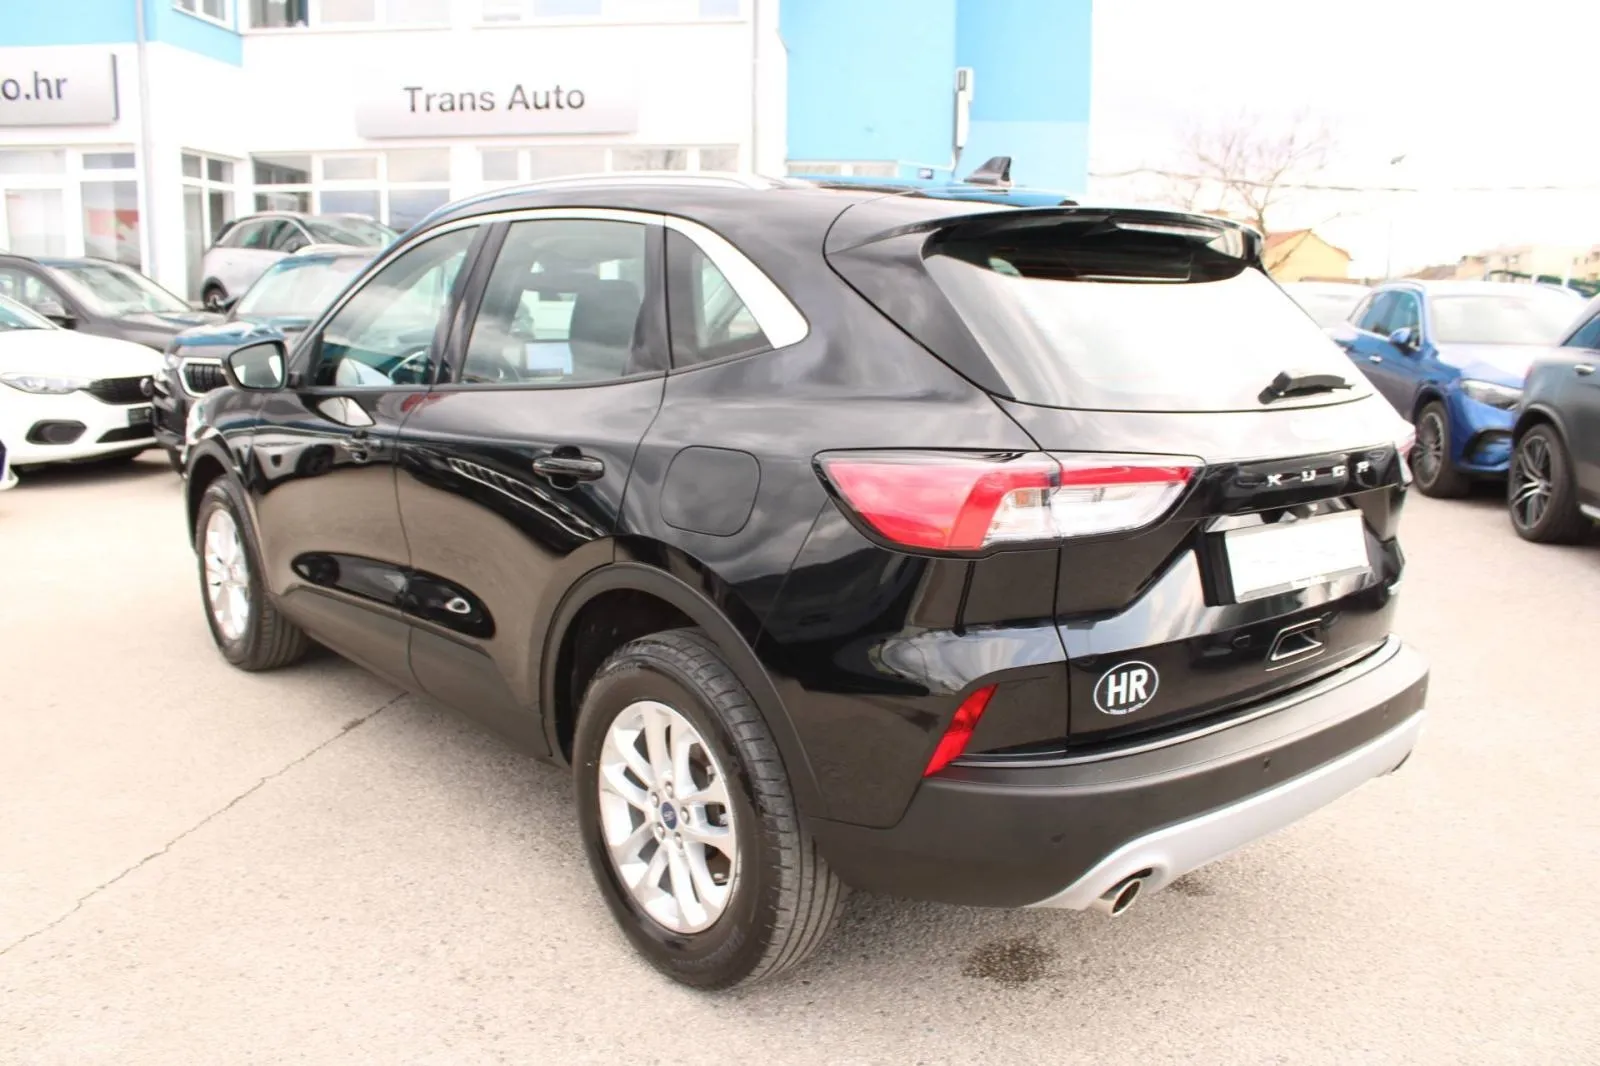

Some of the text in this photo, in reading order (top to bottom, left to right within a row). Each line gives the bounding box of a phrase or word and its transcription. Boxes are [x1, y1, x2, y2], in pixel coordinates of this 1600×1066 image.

[0, 70, 68, 101] o.hr
[403, 83, 586, 113] Trans Auto
[1107, 668, 1148, 707] HR
